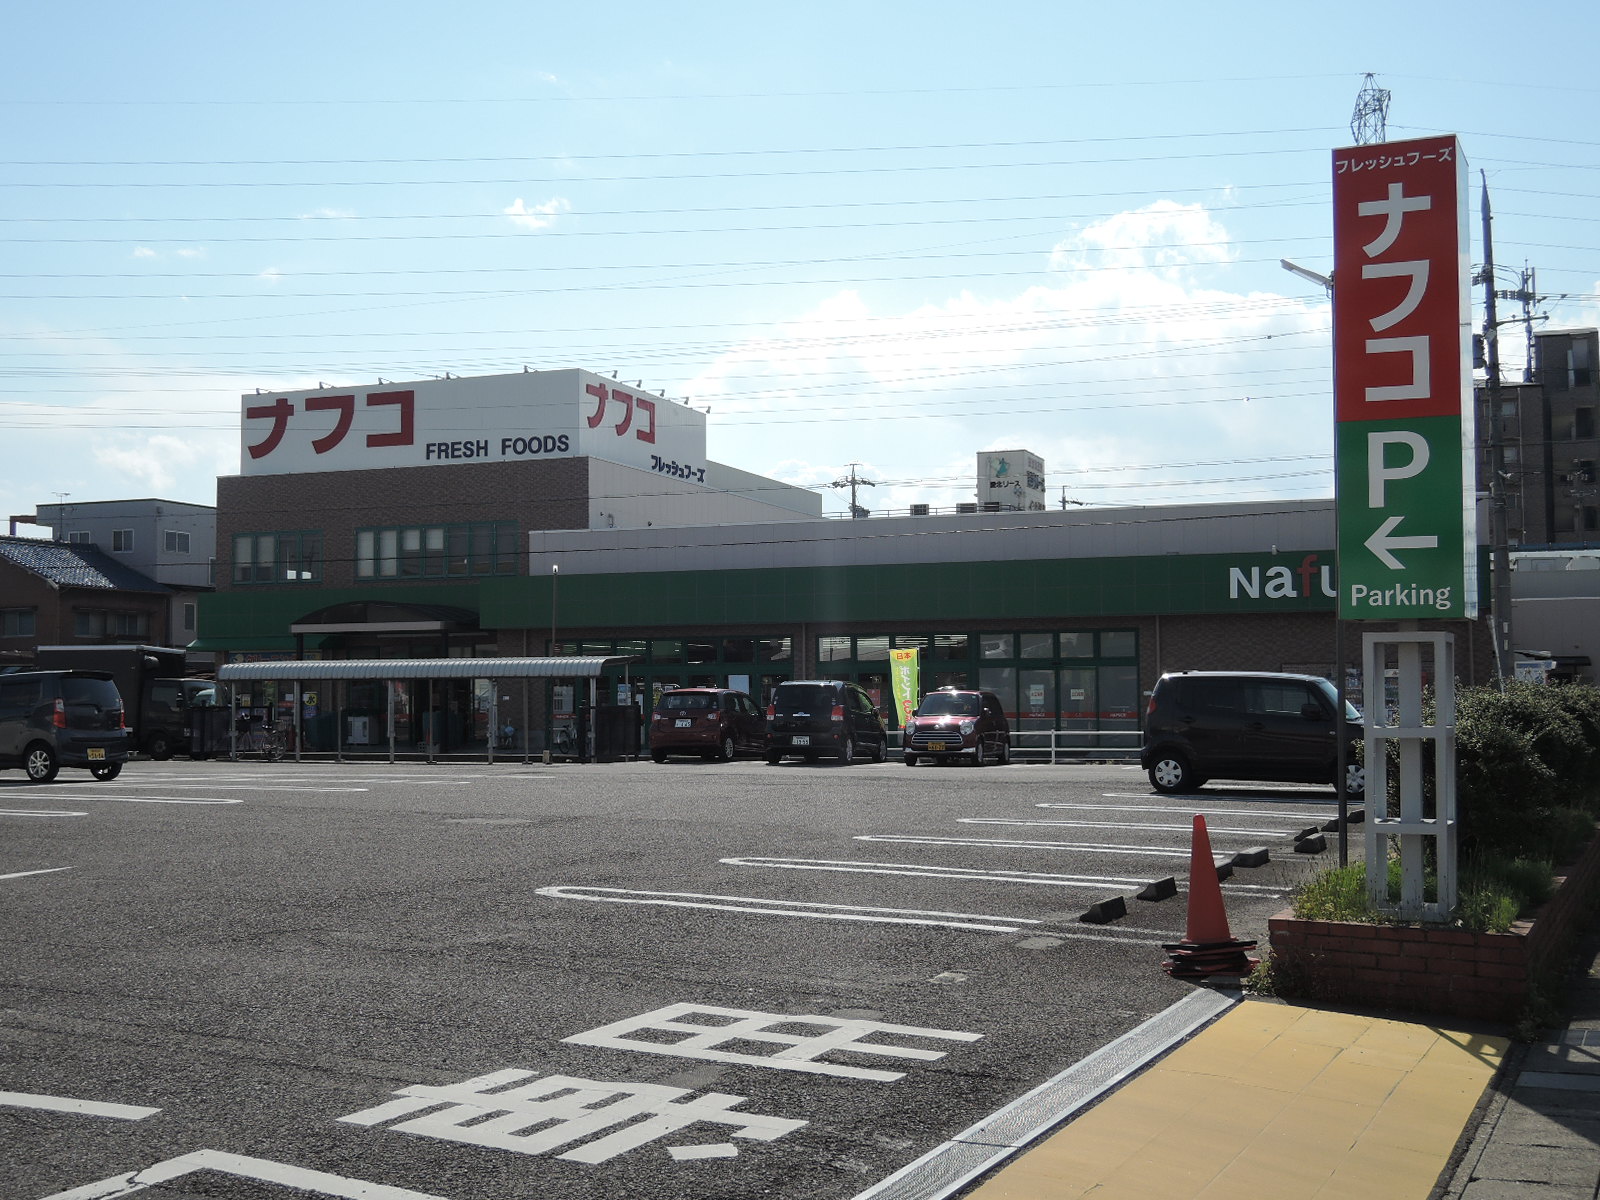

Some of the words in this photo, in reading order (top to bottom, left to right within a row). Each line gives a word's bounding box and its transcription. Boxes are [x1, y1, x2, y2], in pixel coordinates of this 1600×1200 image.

[1335, 146, 1454, 174] フレッシュフーズ
[1357, 182, 1431, 402] ナフコ
[246, 390, 414, 460] ナフコ
[586, 383, 656, 445] ナフコ
[426, 439, 489, 461] FRESH
[501, 434, 569, 455] FOODS
[651, 454, 705, 483] フレッシュフーズ
[1368, 430, 1430, 508] P
[1351, 583, 1452, 610] Parking
